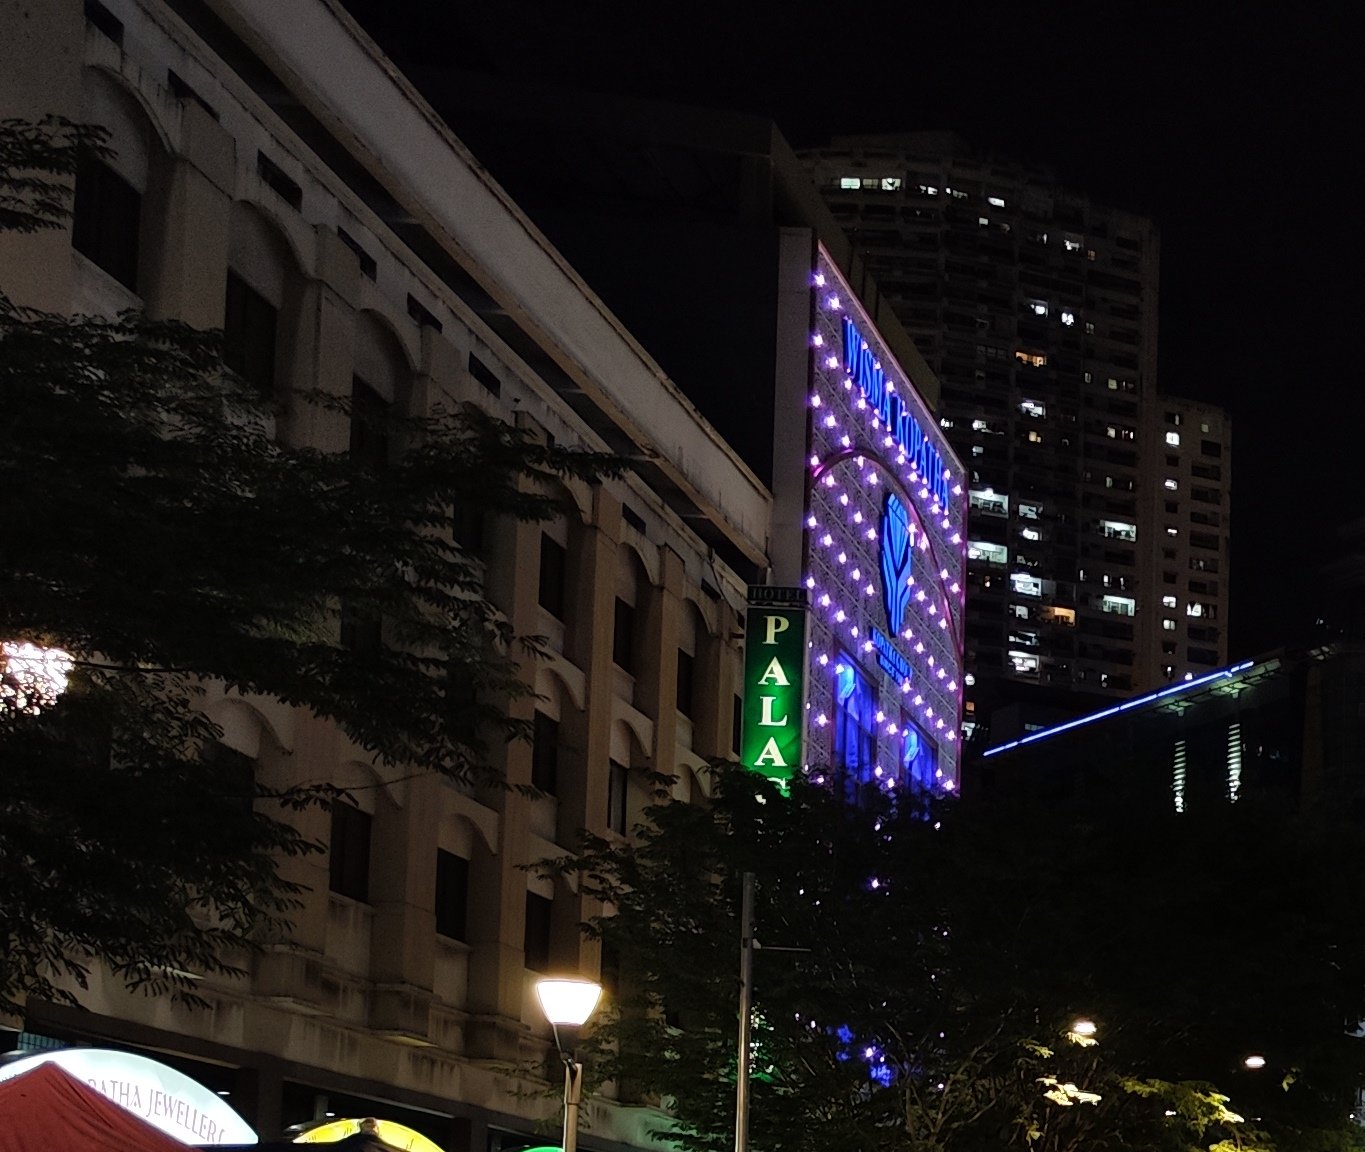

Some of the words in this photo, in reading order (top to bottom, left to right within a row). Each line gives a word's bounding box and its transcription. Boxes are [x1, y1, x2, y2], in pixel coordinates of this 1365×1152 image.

[845, 317, 892, 431] WISMA
[895, 398, 950, 514] KOPATHA
[753, 614, 791, 789] PALA
